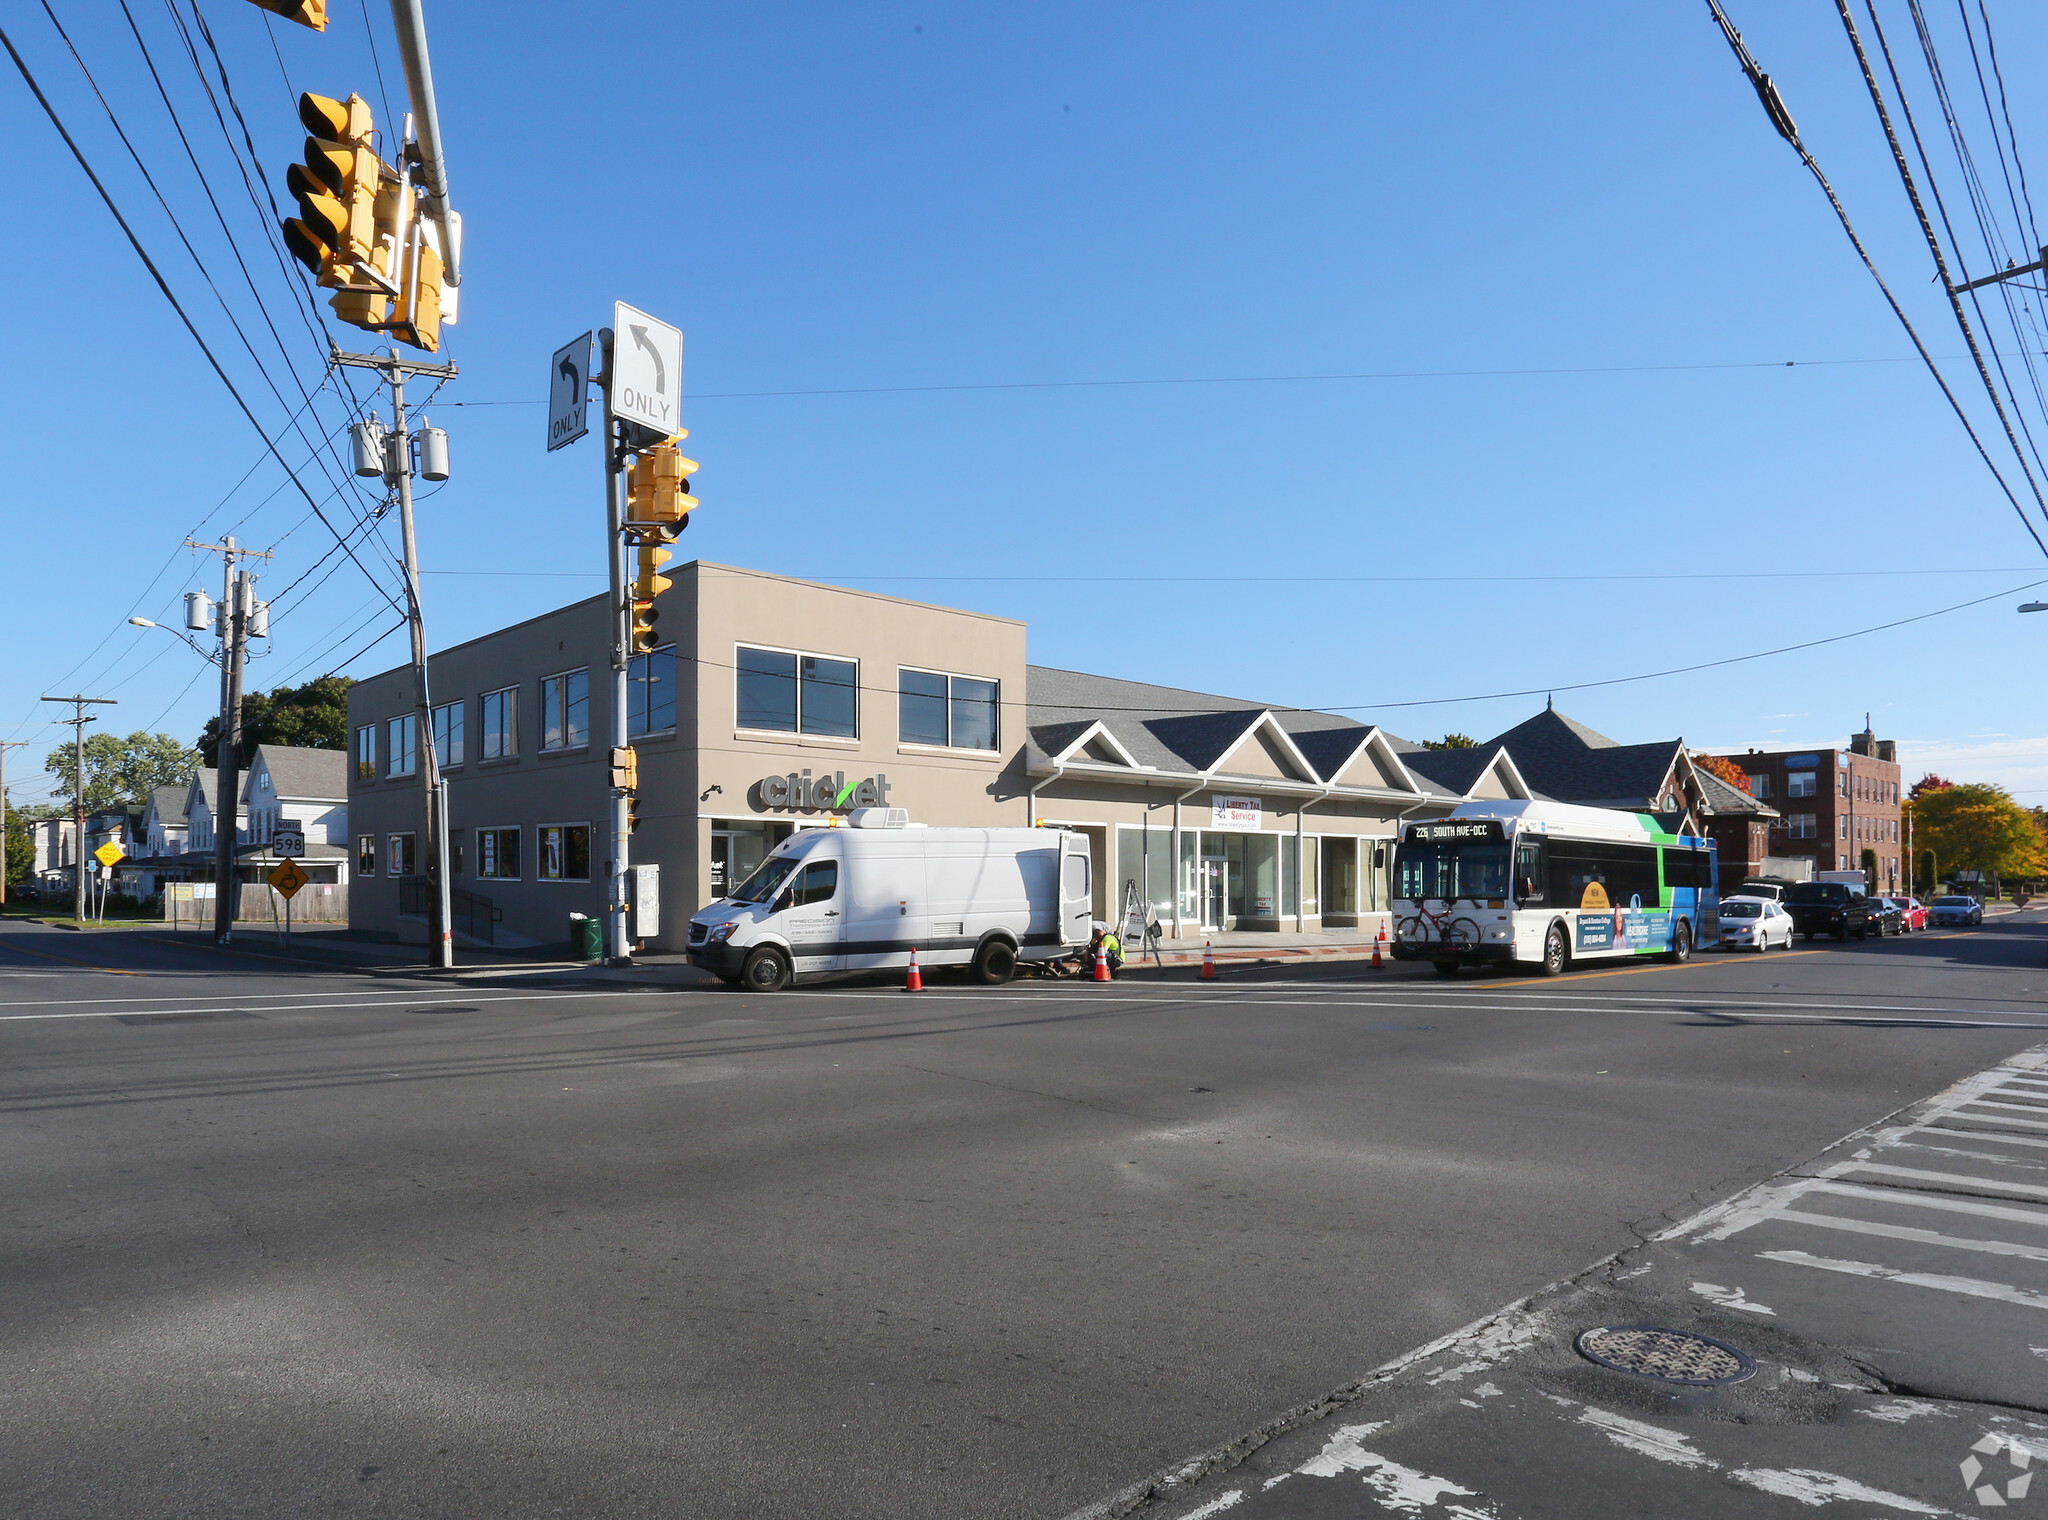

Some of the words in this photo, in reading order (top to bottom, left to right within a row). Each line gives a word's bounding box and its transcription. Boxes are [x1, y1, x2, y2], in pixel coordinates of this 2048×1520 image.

[624, 387, 670, 421] ONLY
[553, 407, 581, 439] ONLY
[760, 768, 891, 808] cricket
[1226, 799, 1248, 809] LIBERTY
[1231, 810, 1256, 821] Service
[277, 821, 300, 830] NORTH
[1433, 826, 1455, 837] SOUTH
[275, 838, 302, 851] 598
